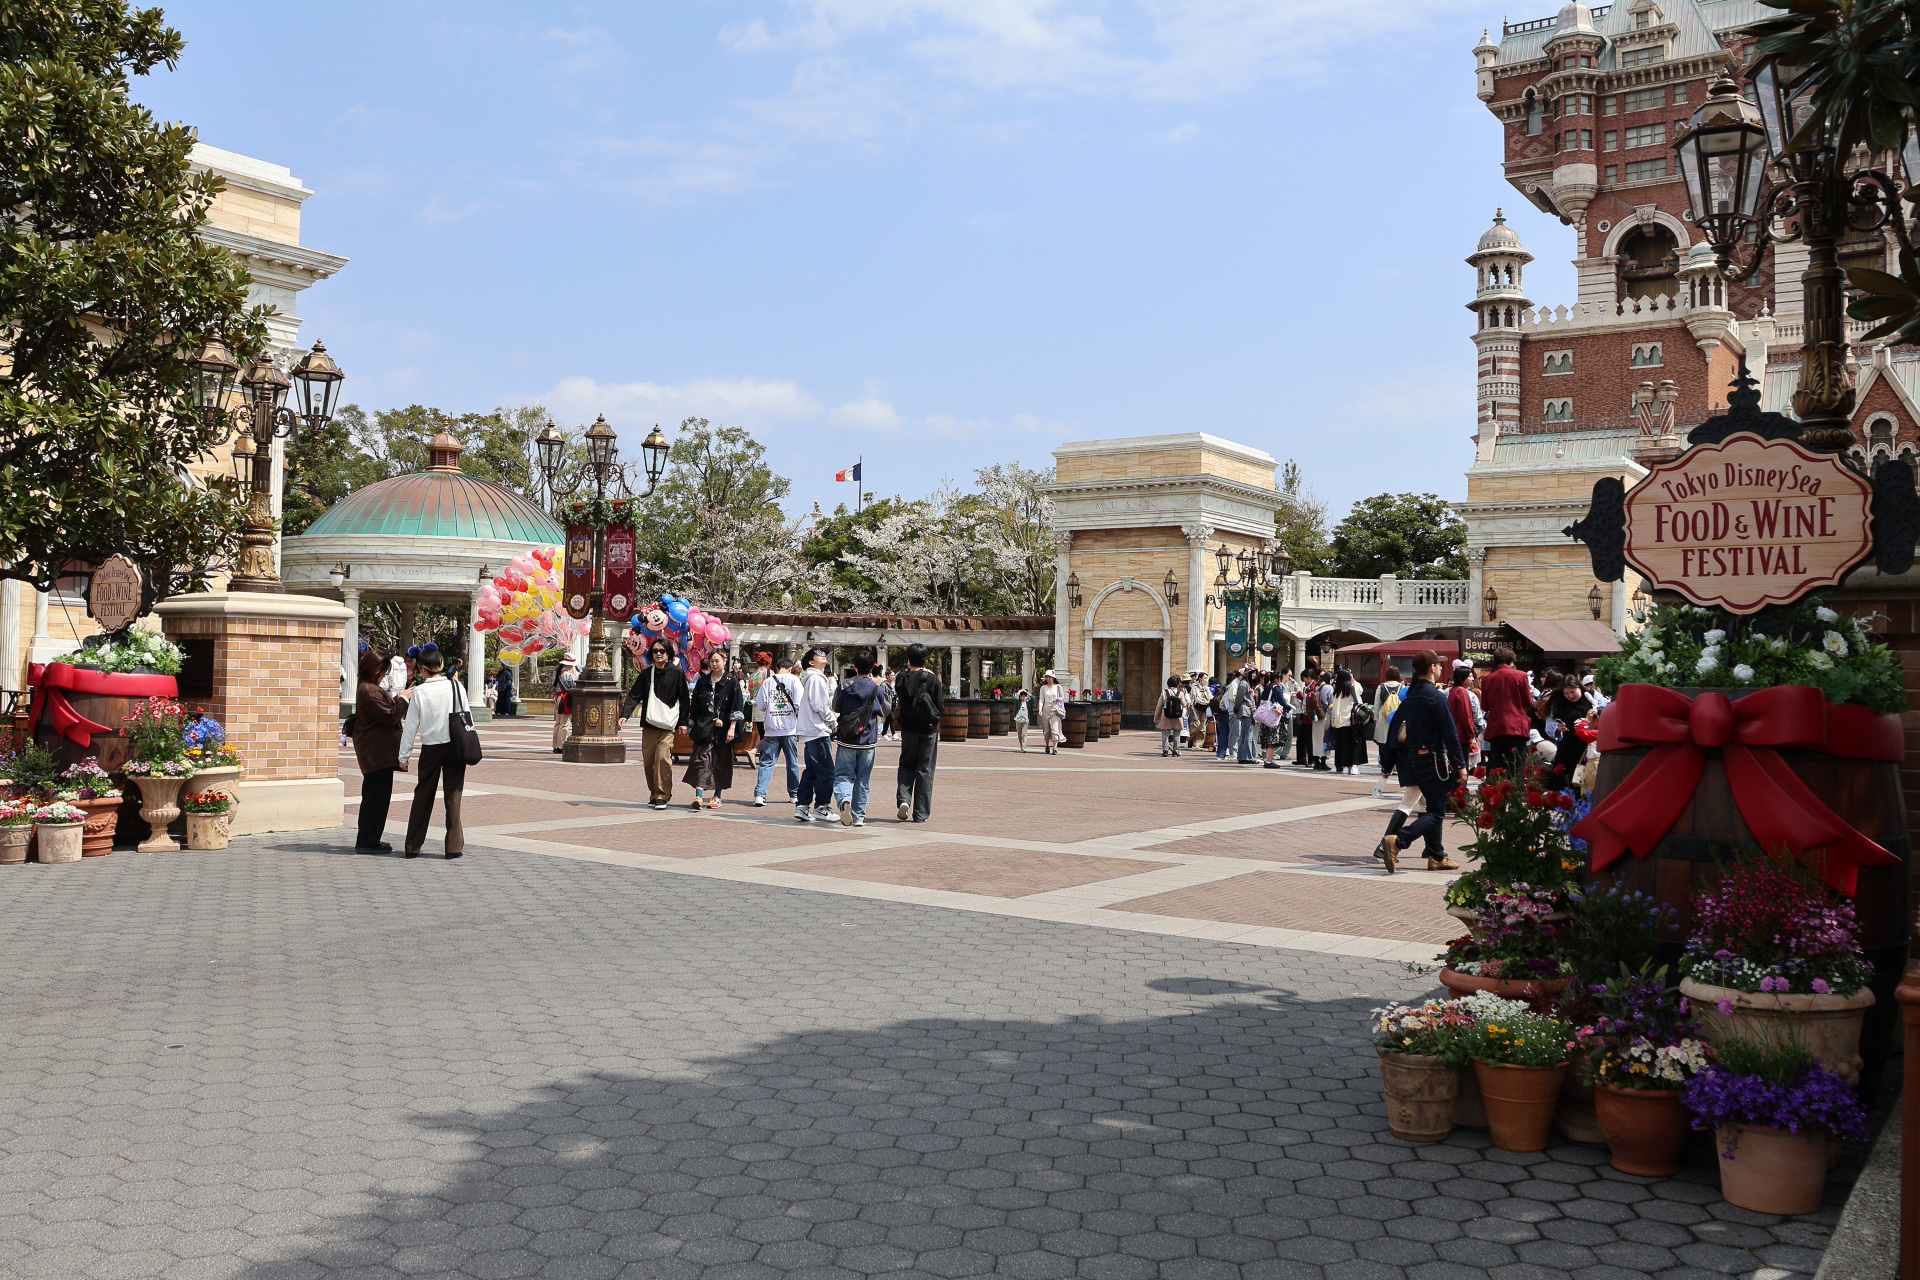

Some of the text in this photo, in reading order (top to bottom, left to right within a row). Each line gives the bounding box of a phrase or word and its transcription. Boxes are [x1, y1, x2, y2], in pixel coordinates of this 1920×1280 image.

[1661, 462, 1822, 503] Tokyo DisneySea
[1096, 498, 1158, 511] MUSIC
[1528, 518, 1562, 528] ART
[1654, 497, 1837, 543] FOOD & WINE
[1681, 545, 1807, 578] FESTIVAL
[380, 568, 437, 577] FRIENDSHIP
[96, 583, 111, 601] FOOD
[115, 583, 132, 600] WINE
[101, 603, 125, 616] FESTIVAL
[1465, 638, 1513, 650] Beverages
